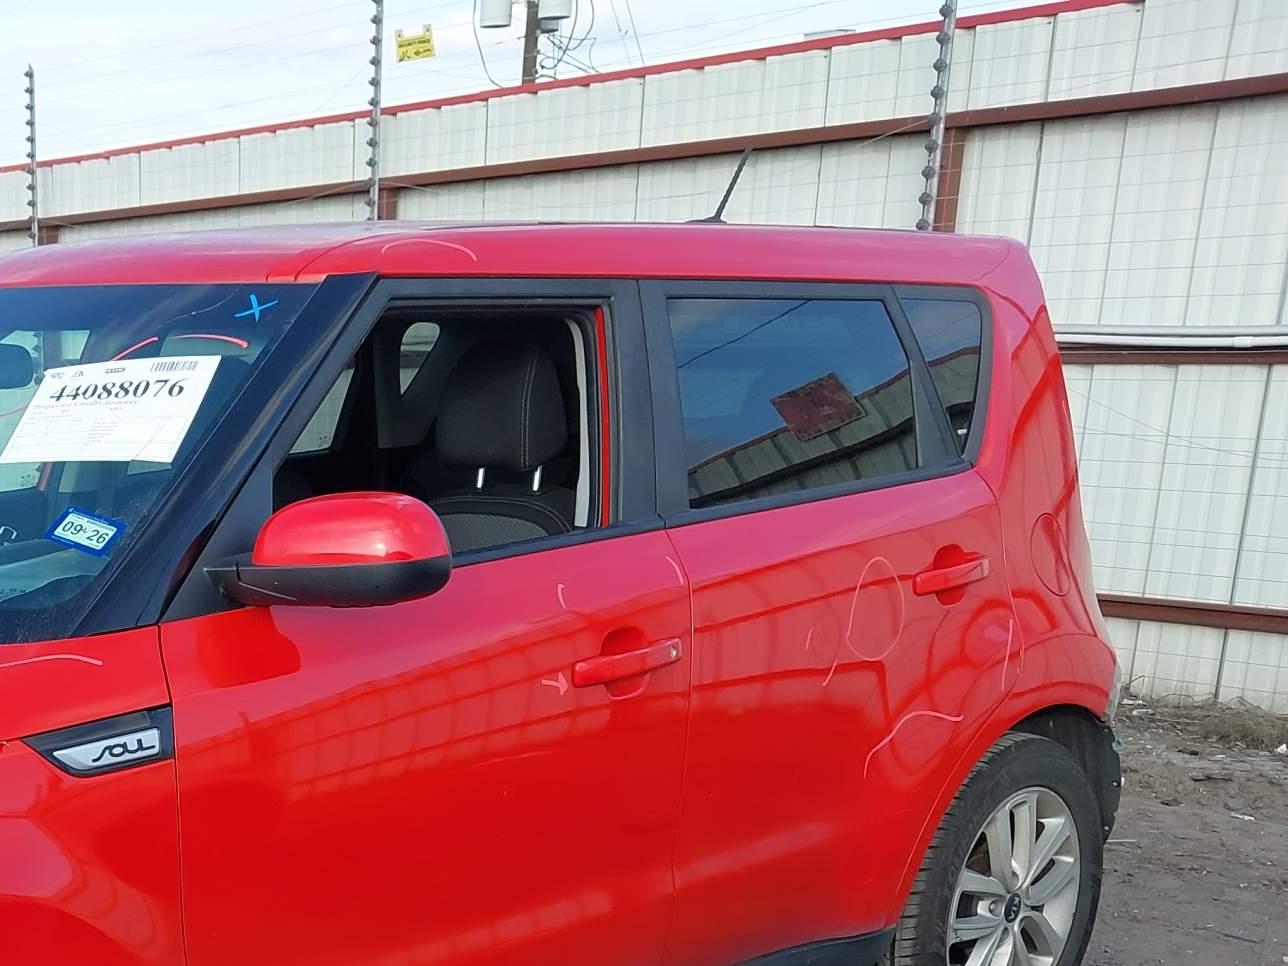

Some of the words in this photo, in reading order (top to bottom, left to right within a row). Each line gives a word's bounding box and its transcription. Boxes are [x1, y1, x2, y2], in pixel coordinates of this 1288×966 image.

[49, 378, 189, 402] 44088076
[62, 520, 84, 536] 09
[85, 529, 109, 544] 26
[92, 738, 156, 763] SOUL
